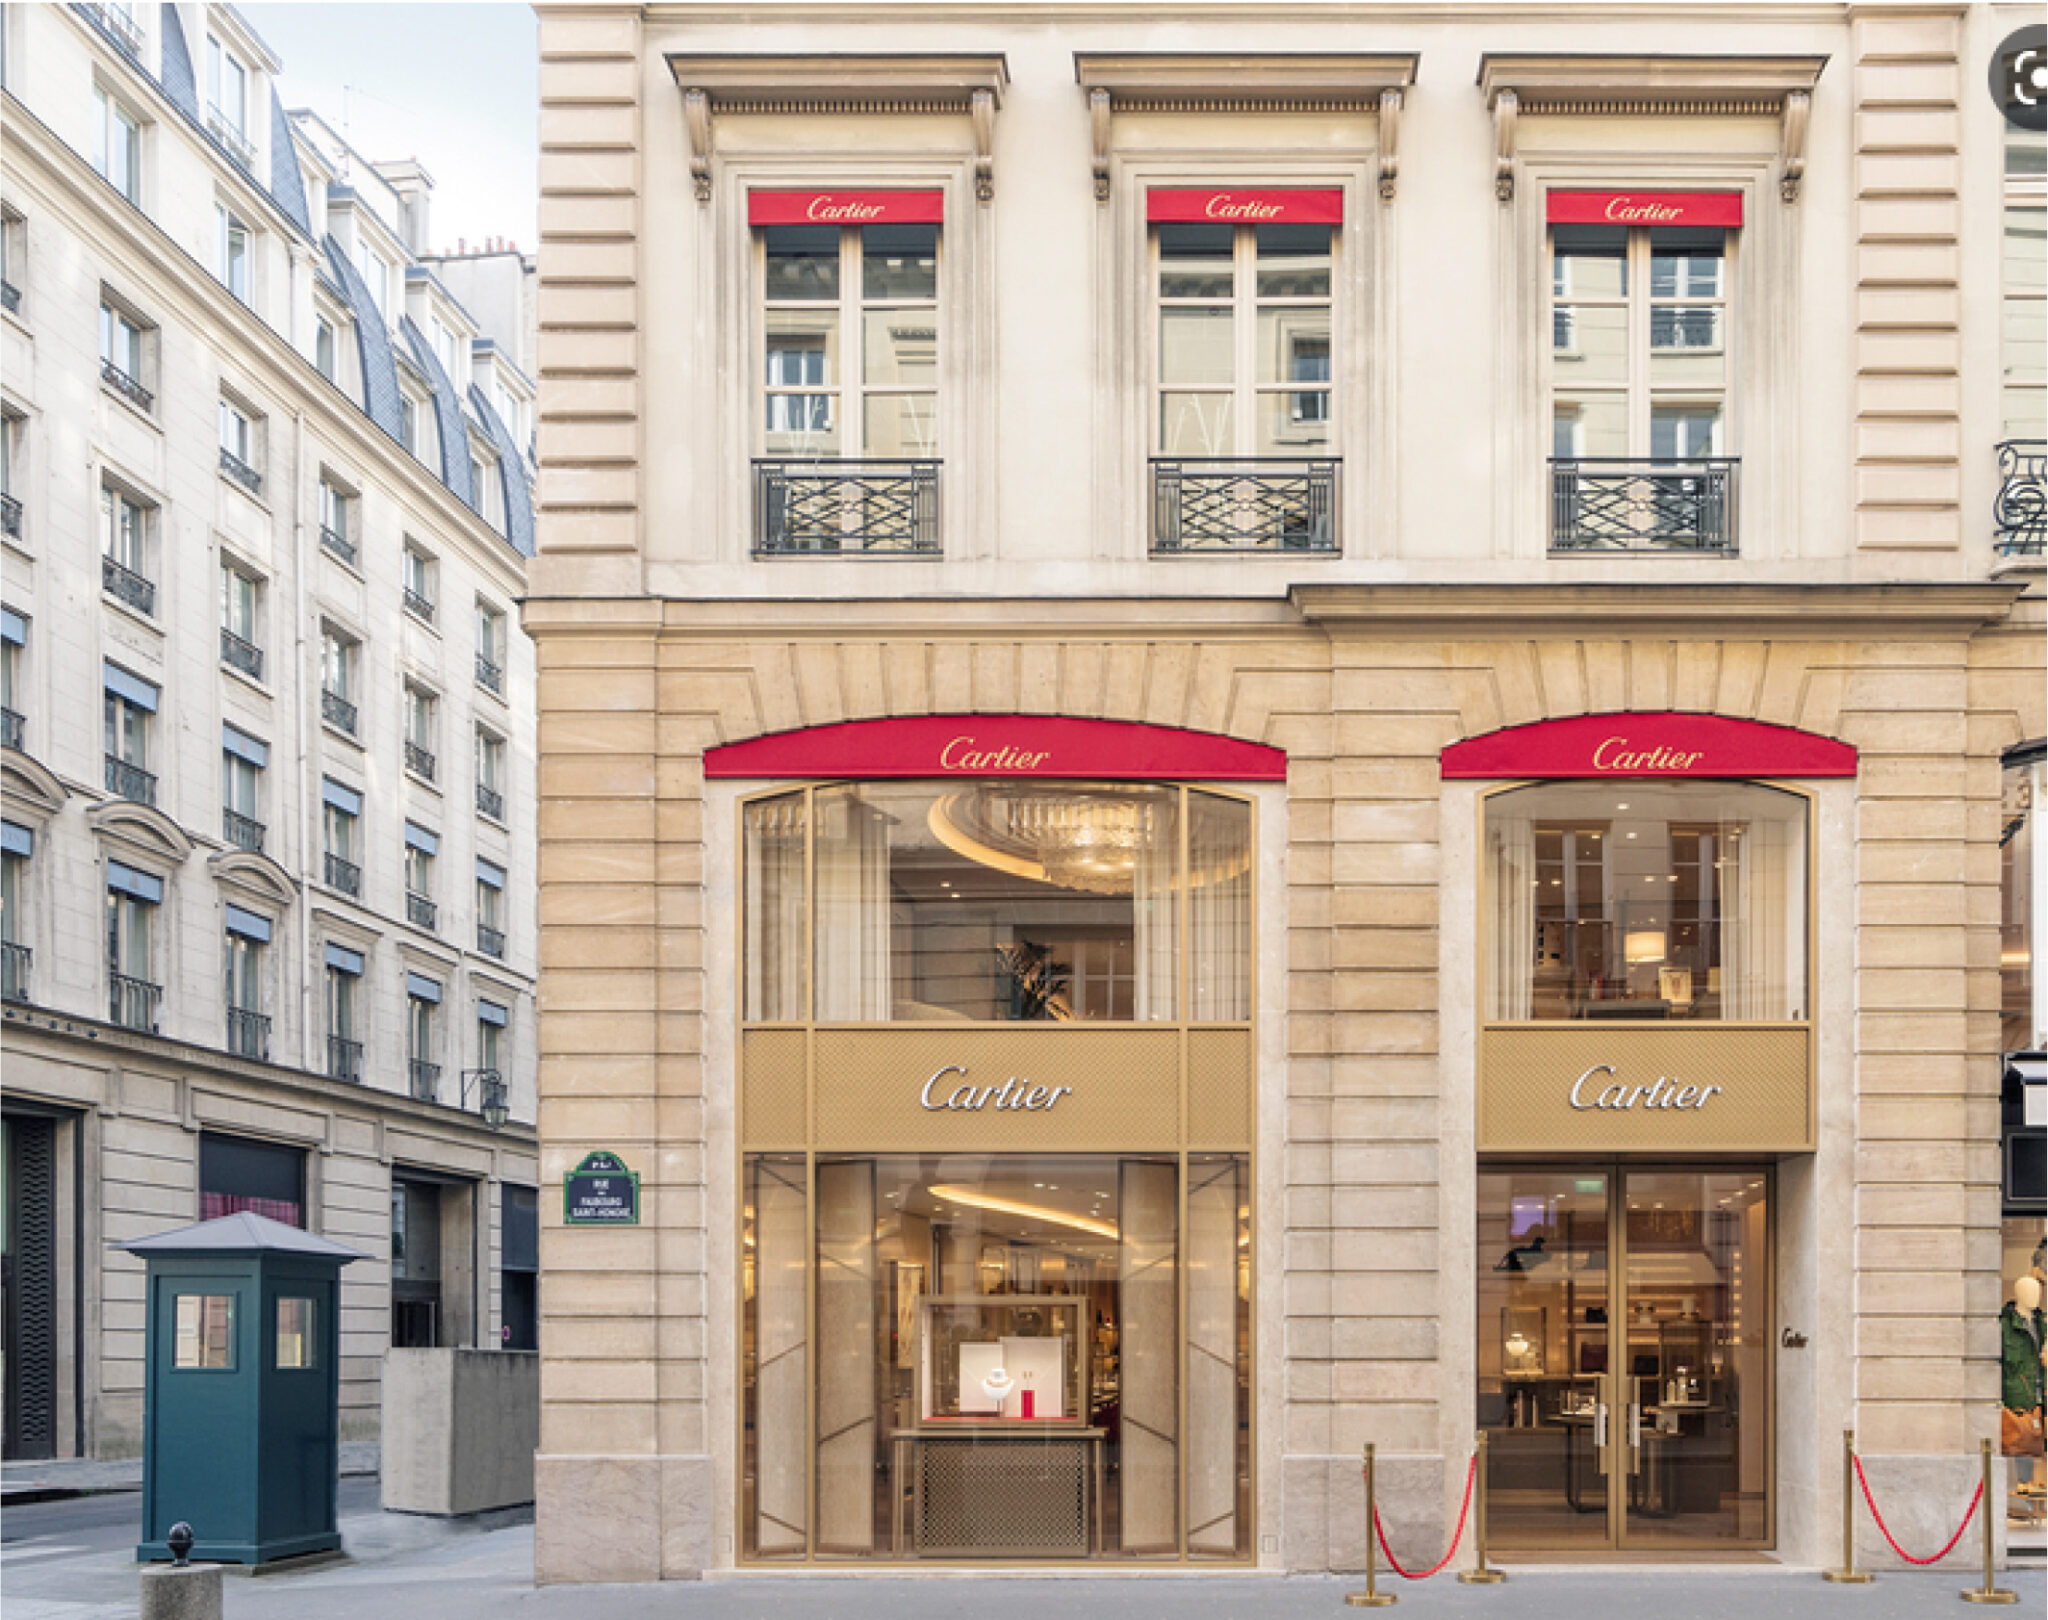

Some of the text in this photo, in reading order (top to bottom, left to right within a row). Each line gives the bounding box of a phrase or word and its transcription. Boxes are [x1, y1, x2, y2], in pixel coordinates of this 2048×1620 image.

[806, 195, 886, 220] Cartier
[1205, 194, 1285, 218] Cartier
[1604, 196, 1684, 221] Cartier
[940, 735, 1051, 770] Cartier
[1593, 735, 1704, 770] Cartier
[921, 1064, 1073, 1111] Cartier
[1569, 1063, 1723, 1110] Cartier
